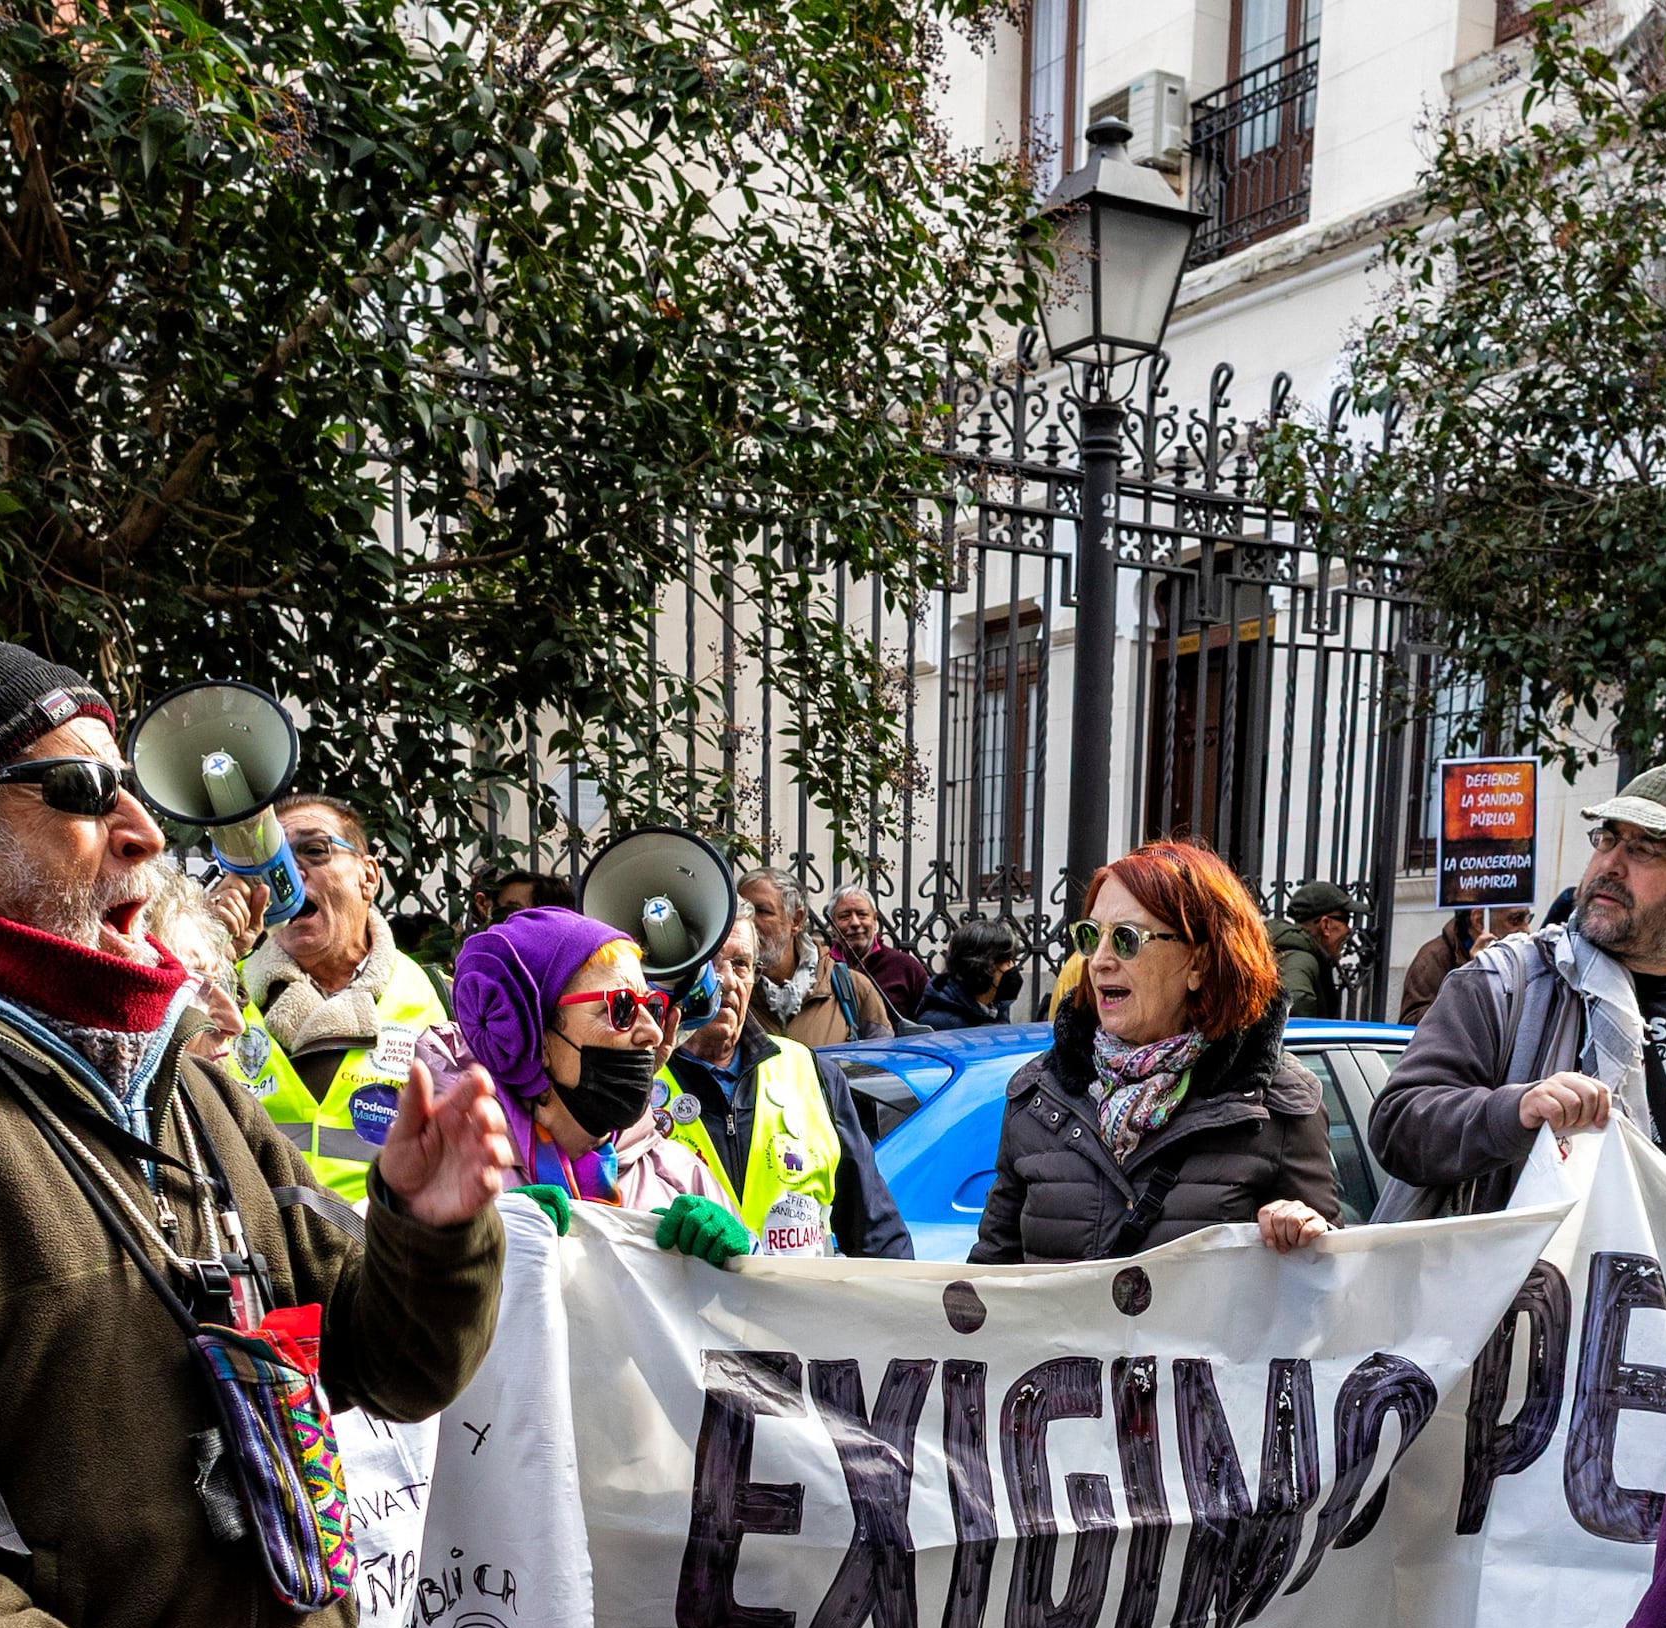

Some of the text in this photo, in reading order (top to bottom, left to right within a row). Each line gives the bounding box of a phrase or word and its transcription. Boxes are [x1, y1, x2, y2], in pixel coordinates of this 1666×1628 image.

[1465, 772, 1521, 788] DEFIENDE
[1461, 792, 1524, 808] LA SANIDAD
[1470, 810, 1516, 827] PÚBLICA
[1444, 855, 1531, 871] LA CONCERTADA
[1459, 874, 1517, 890] VAMPIRIZA
[385, 1048, 411, 1057] PASO
[399, 1041, 412, 1049] UN
[353, 1109, 388, 1124] Madrid
